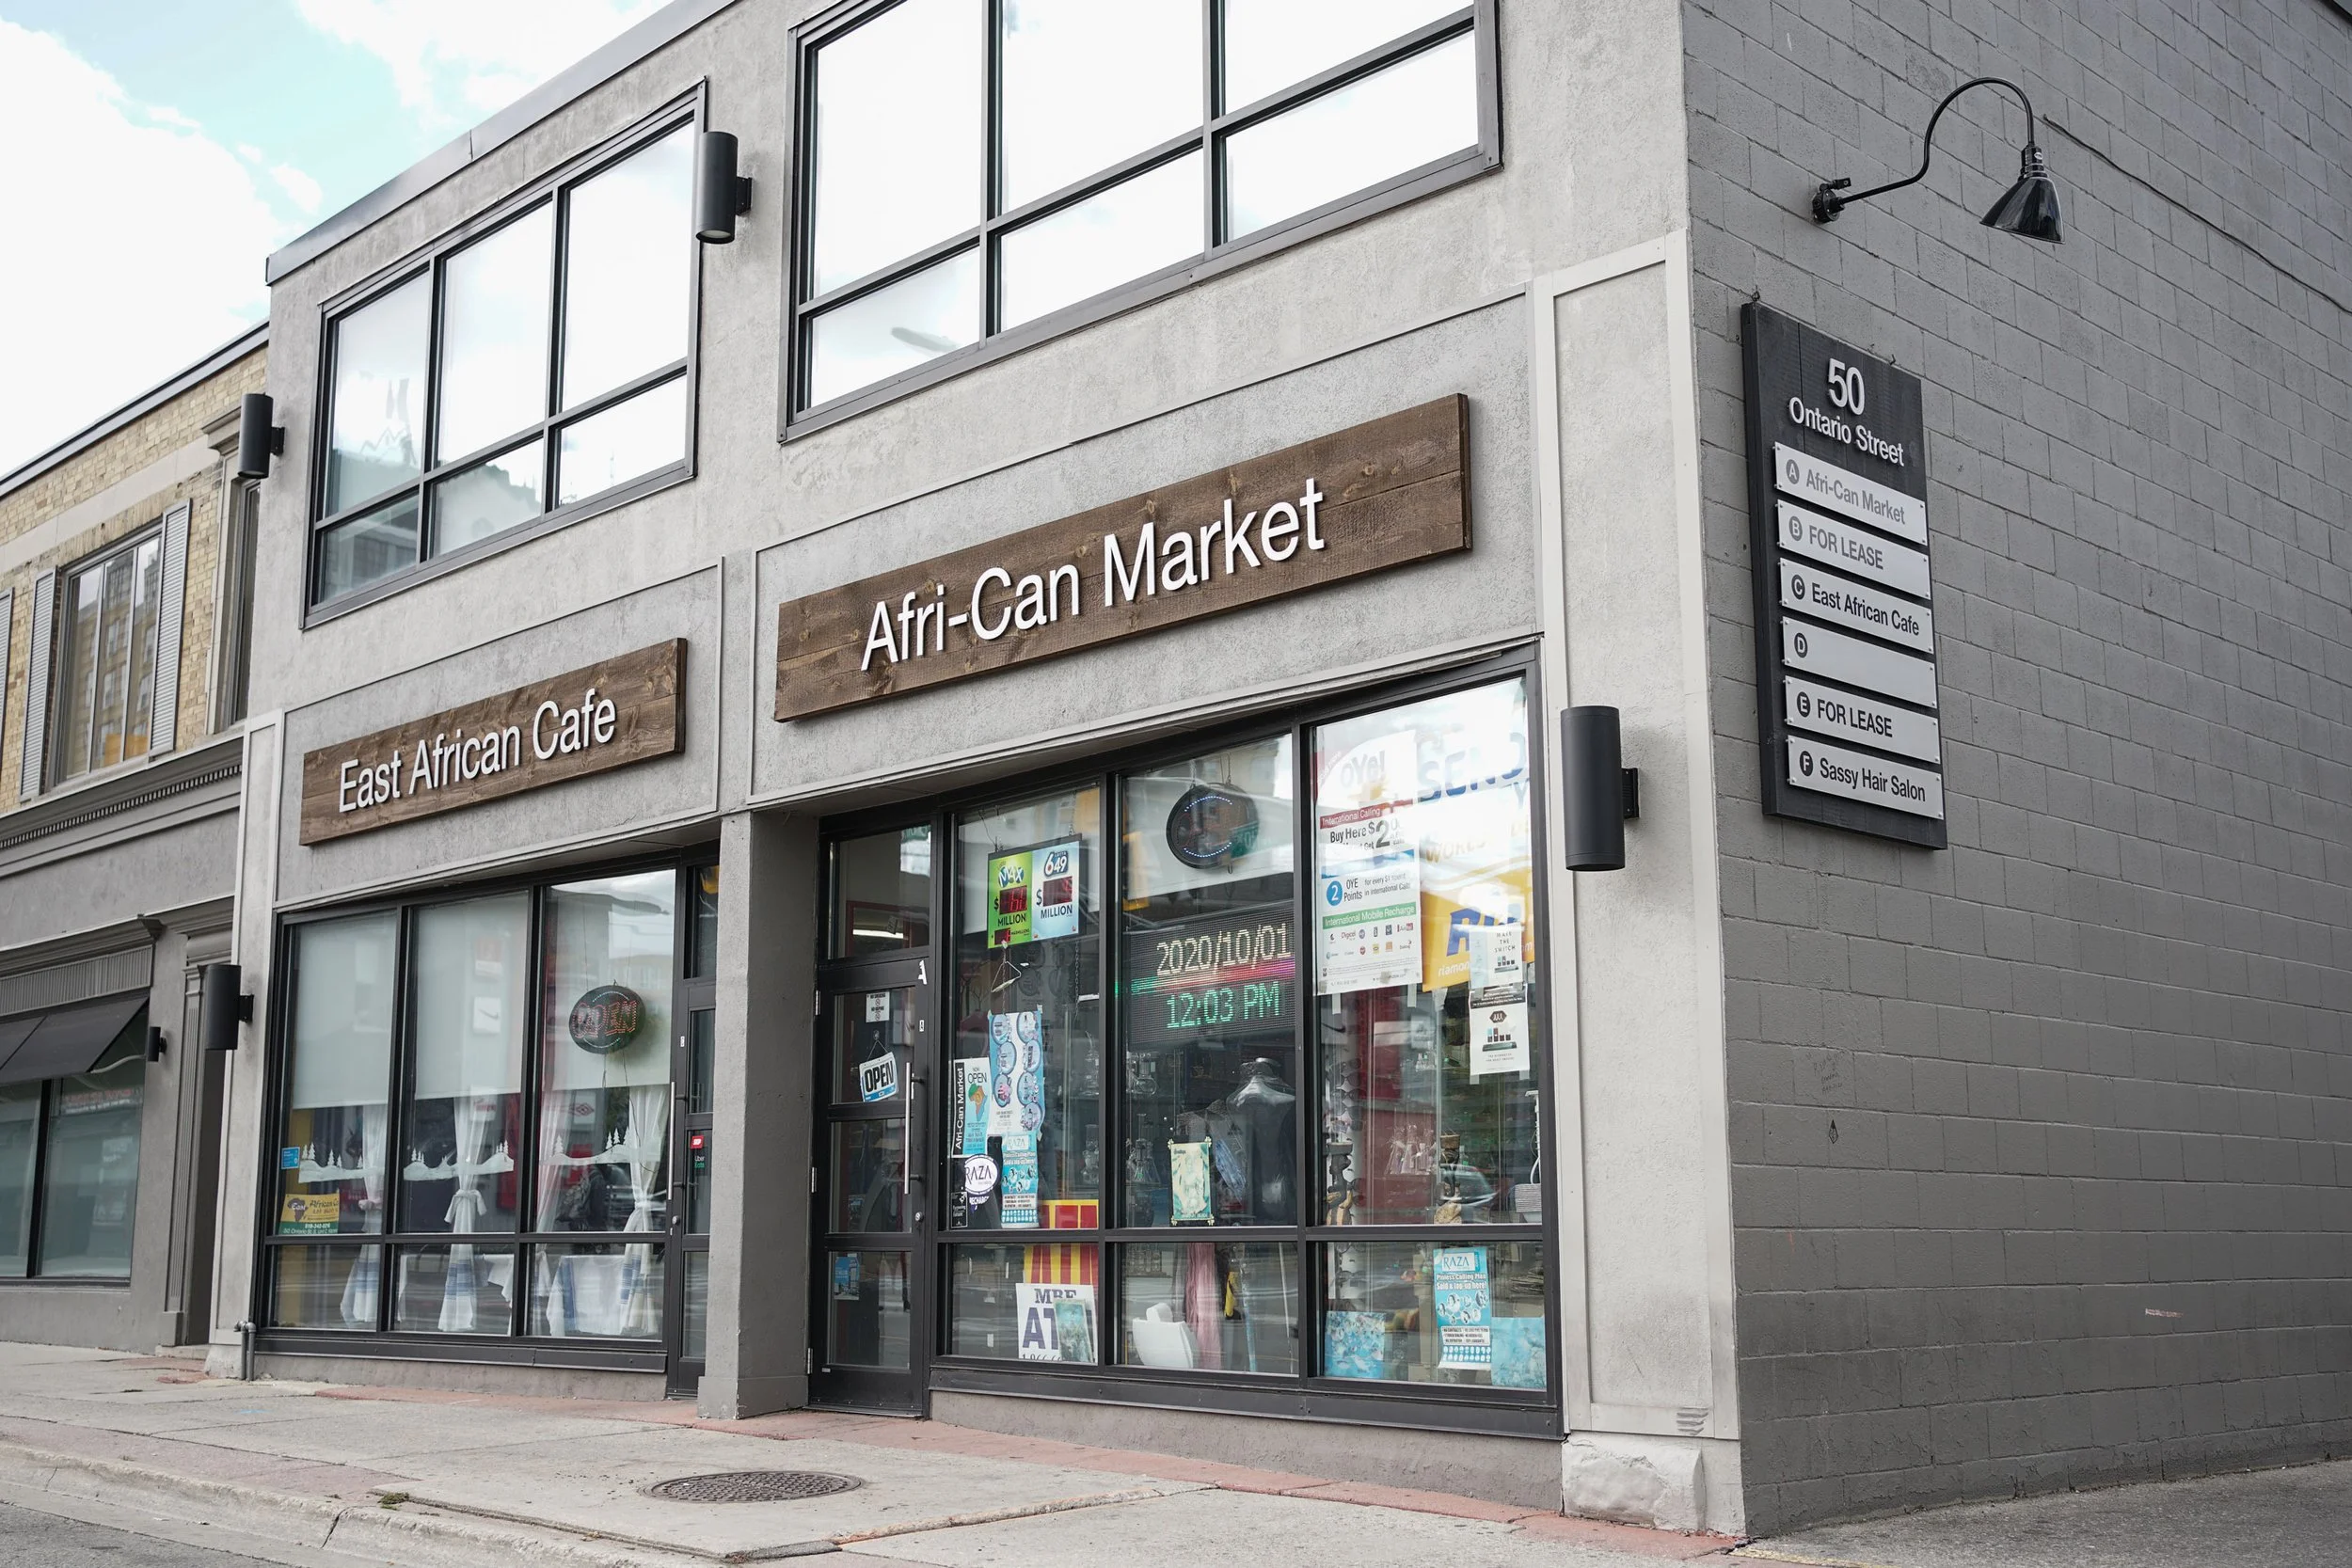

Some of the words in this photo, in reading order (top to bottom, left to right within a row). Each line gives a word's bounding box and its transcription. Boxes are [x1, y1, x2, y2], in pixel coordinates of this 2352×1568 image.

[1828, 357, 1866, 416] 50
[1788, 397, 1851, 445] Ontario
[1855, 425, 1905, 467] Street
[1788, 461, 1798, 483] A
[1806, 468, 1859, 506] Afri-Can
[1862, 490, 1905, 525] Market
[1791, 518, 1801, 539] B
[1809, 525, 1837, 553] FOR
[1841, 537, 1883, 570] LEASE
[860, 563, 1080, 672] Afri-Can
[1104, 478, 1325, 607] Market
[1793, 577, 1804, 597] C
[1812, 582, 1841, 611] East
[1844, 594, 1888, 626] African
[1892, 610, 1920, 637] Cafe
[1796, 635, 1806, 656] D
[1799, 694, 1808, 715] E
[1818, 699, 1846, 726] FOR
[1851, 707, 1893, 737] LEASE
[339, 750, 401, 813] East
[408, 725, 520, 796] African
[532, 688, 616, 760] Cafe
[1802, 753, 1811, 774] F
[1820, 758, 1859, 790] Sassy
[1863, 768, 1888, 793] Hair
[1891, 775, 1926, 802] Salon
[1322, 812, 1359, 826] International
[1360, 808, 1381, 820] Calling
[1330, 832, 1344, 843] Buy
[1345, 826, 1366, 839] Here
[999, 865, 1024, 887] MAX
[1346, 878, 1359, 890] OYE
[1373, 877, 1384, 886] every
[993, 896, 998, 910] $
[1036, 889, 1042, 905] $
[1343, 891, 1362, 902] Points
[997, 913, 1026, 927] MILLION
[1040, 905, 1073, 919] MILLION
[1325, 915, 1360, 927] International
[1361, 911, 1383, 922] Mobile
[1384, 906, 1415, 918] Recharge
[1156, 923, 1293, 975] 2020/10/01
[1167, 988, 1235, 1029] 12:03
[1243, 980, 1280, 1021] PM
[864, 1060, 893, 1093] OPEN
[967, 1072, 987, 1084] OPEN
[955, 1108, 964, 1149] Afri-Can
[965, 1165, 992, 1185] RAZA
[1443, 1256, 1470, 1270] RAZA
